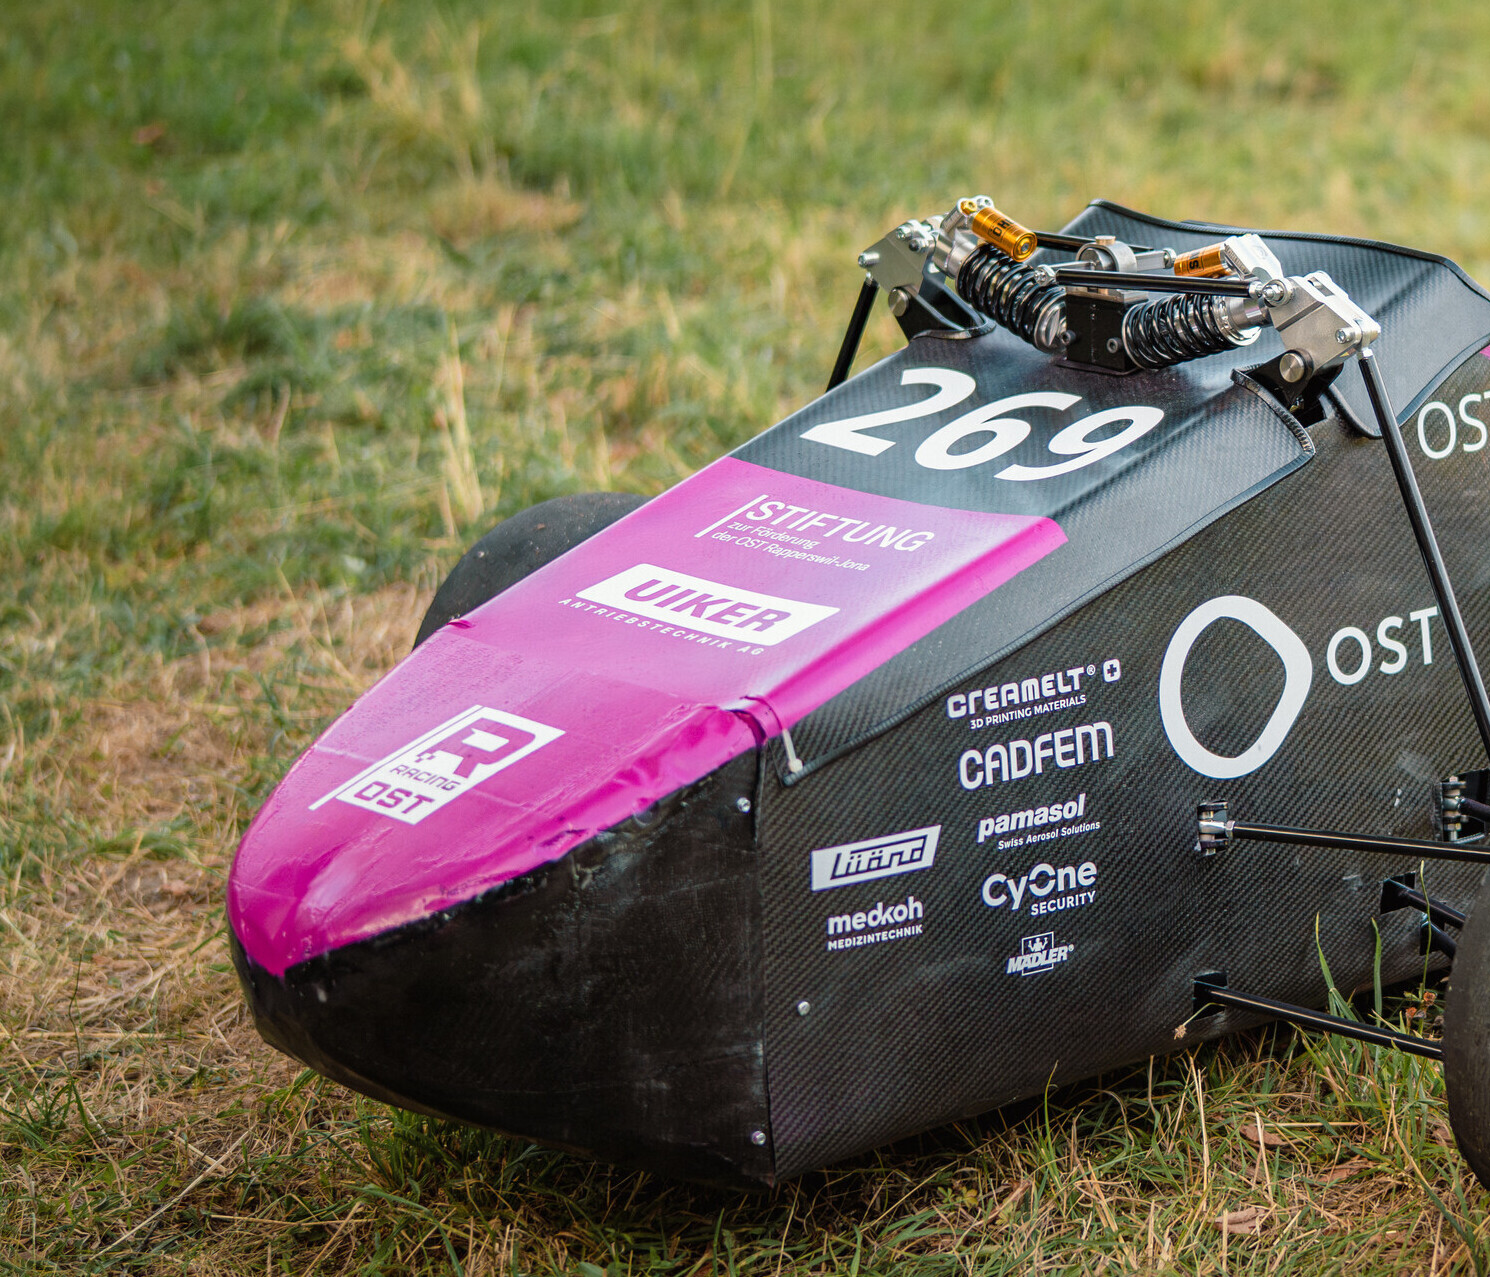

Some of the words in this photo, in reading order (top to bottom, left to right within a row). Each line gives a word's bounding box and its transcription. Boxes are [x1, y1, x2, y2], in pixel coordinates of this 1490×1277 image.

[800, 367, 1164, 481] 269
[727, 522, 753, 532] zur
[751, 526, 820, 550] Förderung
[745, 501, 935, 551] STIFTUNG
[711, 530, 737, 542] der
[734, 536, 769, 549] OST
[762, 543, 871, 571] Rapperswil-Jona
[624, 579, 791, 632] UIKER
[558, 598, 732, 649] ANTRIEBSTECHNIK
[737, 645, 764, 655] AG
[1327, 606, 1438, 685] OST
[970, 718, 984, 729] 3D
[986, 707, 1032, 726] PRINTING
[1034, 694, 1087, 715] MATERIALS
[959, 721, 1114, 790] CADFEM
[354, 781, 435, 814] OST
[390, 764, 460, 791] RACING
[977, 793, 1086, 843] pamasol
[998, 837, 1024, 850] Swiss
[1026, 829, 1059, 844] Aerosol
[1061, 821, 1100, 836] Solutions
[981, 861, 1097, 911] CyOne
[1031, 890, 1096, 915] SECURITY
[828, 896, 924, 935] medkoh
[828, 924, 924, 951] MEDIZINTECHNIK
